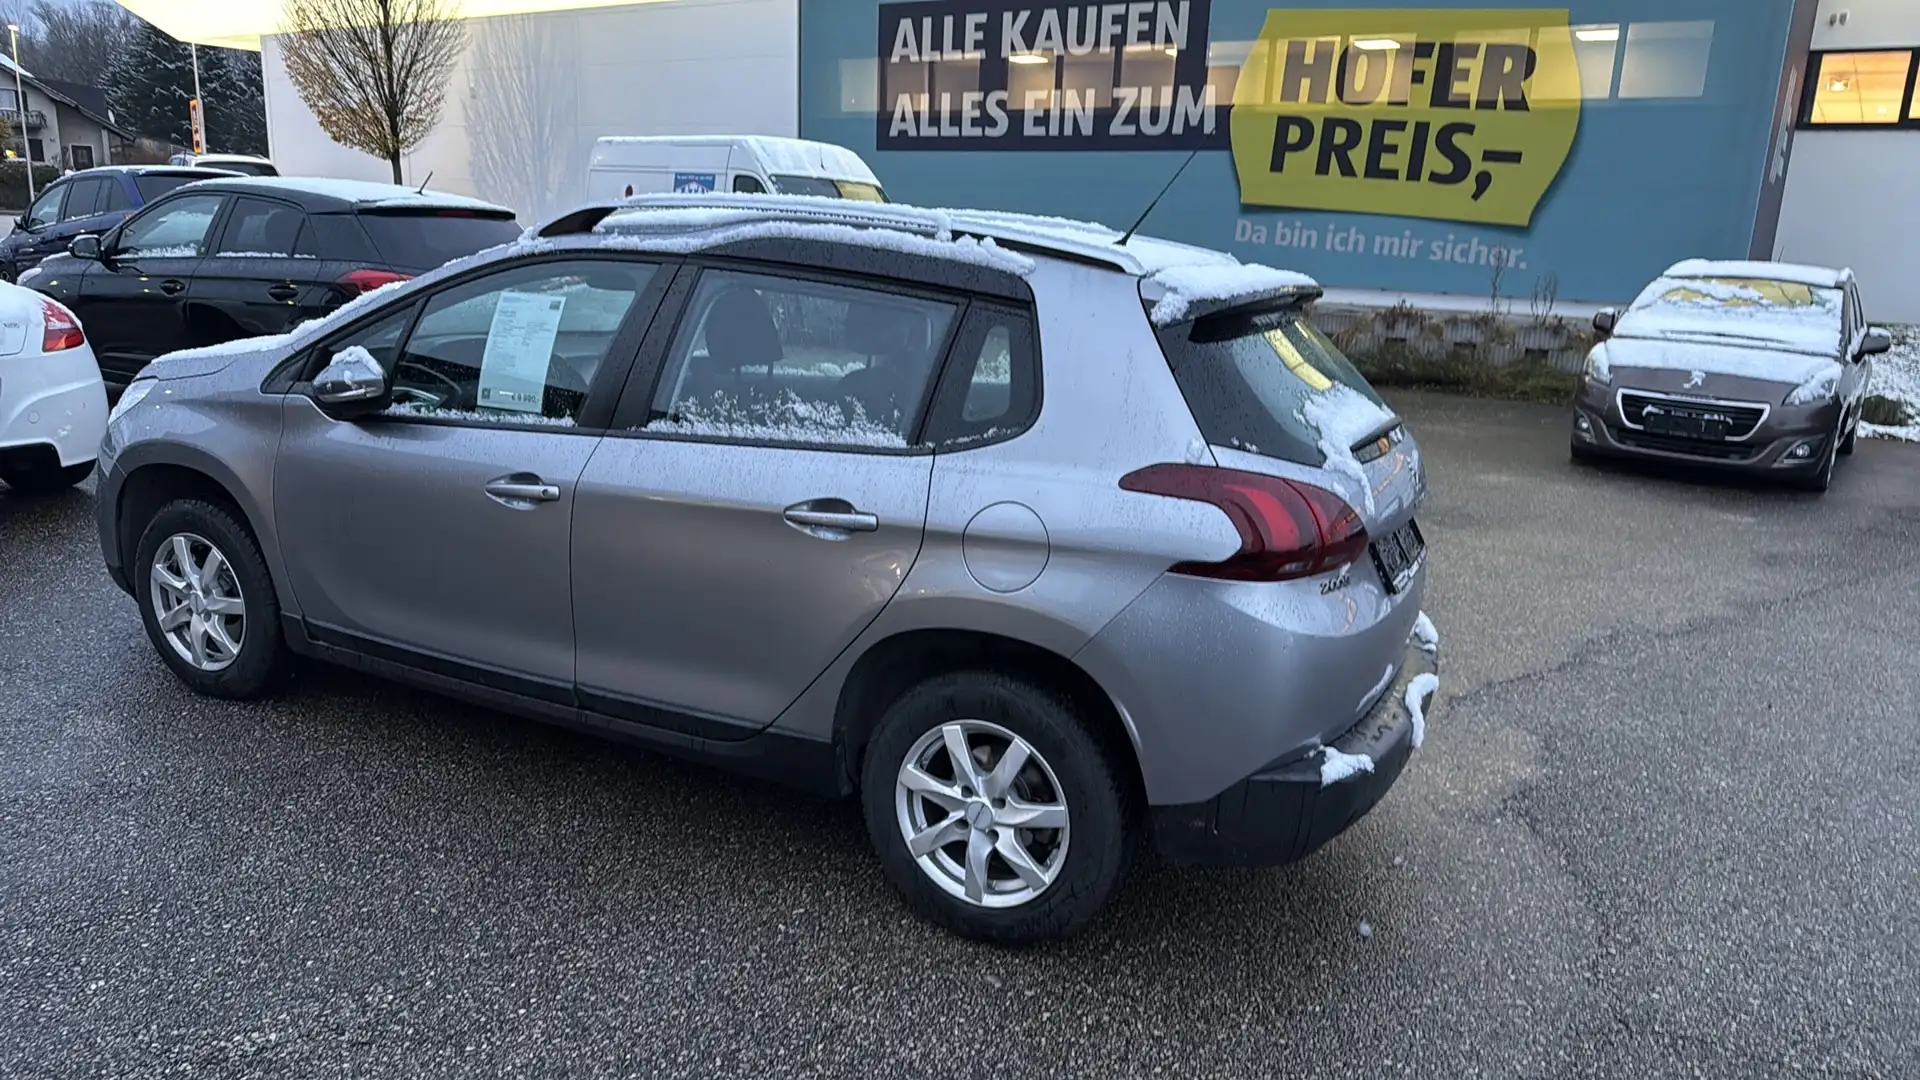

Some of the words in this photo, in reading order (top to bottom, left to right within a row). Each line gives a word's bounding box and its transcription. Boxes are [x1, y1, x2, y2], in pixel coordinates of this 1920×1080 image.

[890, 12, 988, 63] ALLE
[1001, 0, 1190, 58] KAUFEN
[1280, 39, 1537, 112] HOFER
[889, 90, 1008, 138] ALLES
[1023, 88, 1096, 137] EIN
[1109, 85, 1216, 136] ZUM
[1235, 219, 1267, 245] Da
[1274, 221, 1318, 249] bin
[1325, 224, 1366, 252] ich
[1373, 230, 1423, 259] mir
[1429, 234, 1527, 270] sicher.
